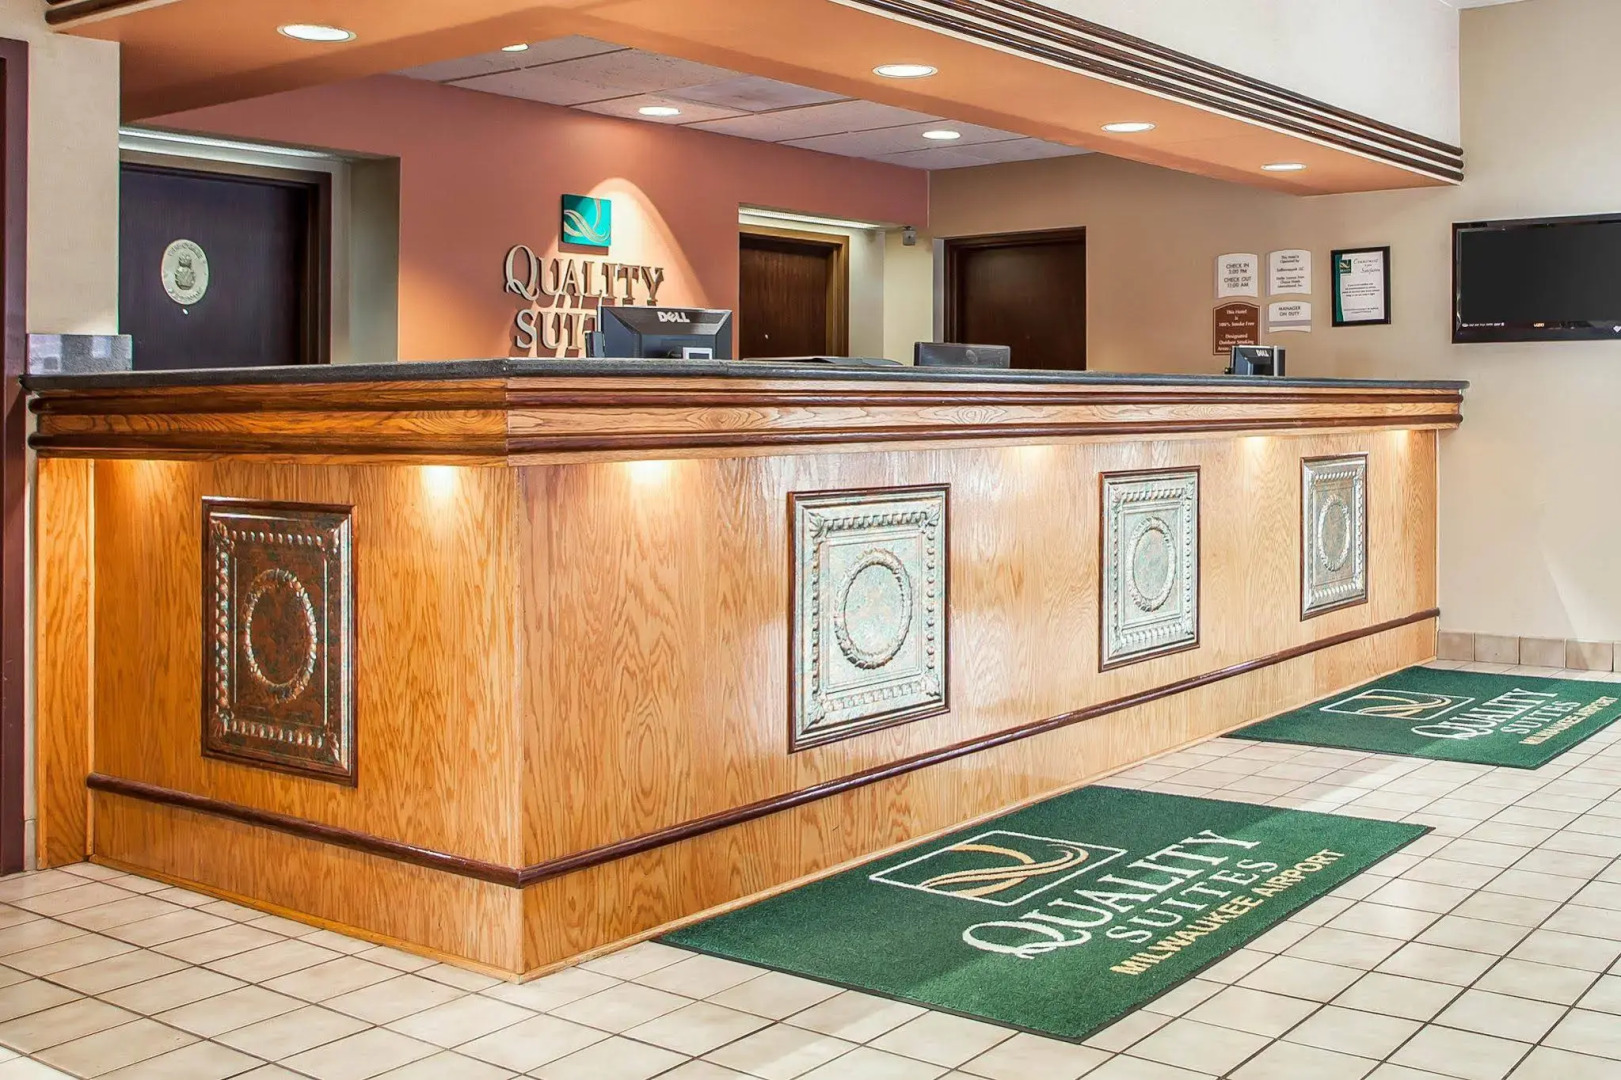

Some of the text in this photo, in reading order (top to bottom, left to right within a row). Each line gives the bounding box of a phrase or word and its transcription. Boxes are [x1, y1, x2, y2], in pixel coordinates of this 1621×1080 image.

[504, 245, 664, 302] QUALITY
[657, 311, 690, 323] DELL
[1410, 688, 1559, 741] QUALITY
[1500, 700, 1581, 735] SUITES
[962, 828, 1262, 960] QUALITY
[1106, 858, 1278, 944] SUITES
[1110, 848, 1345, 976] MILWAUKEE AIRPORT
